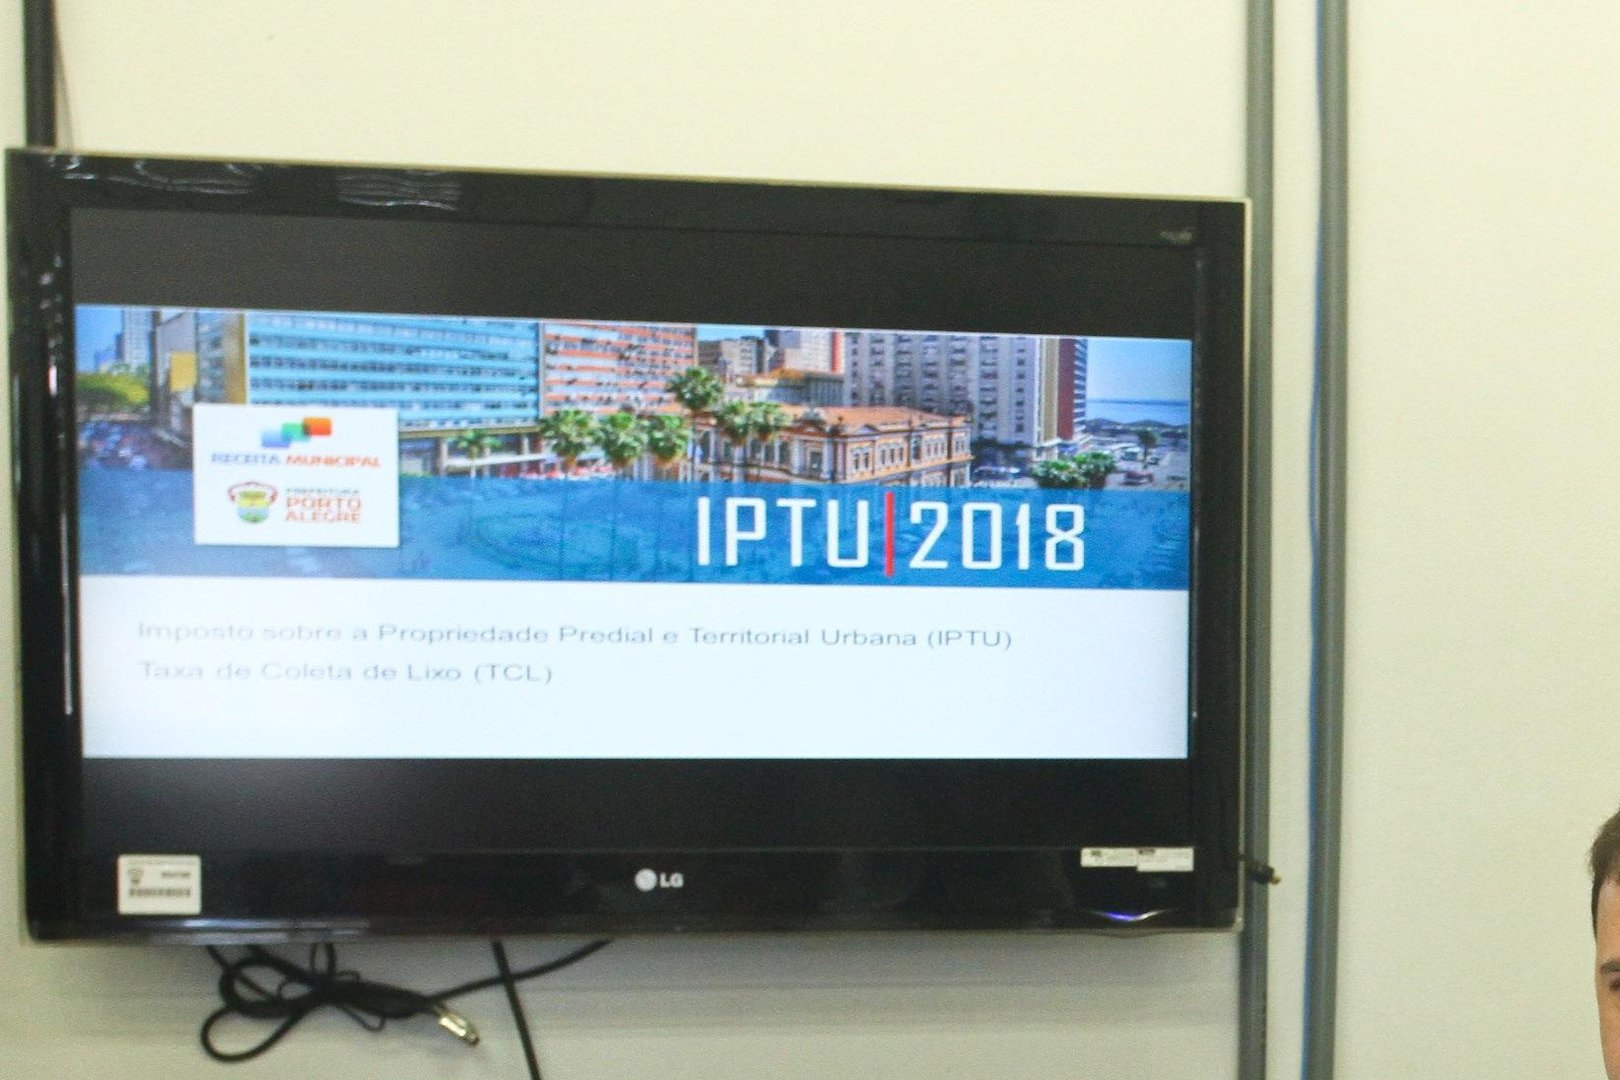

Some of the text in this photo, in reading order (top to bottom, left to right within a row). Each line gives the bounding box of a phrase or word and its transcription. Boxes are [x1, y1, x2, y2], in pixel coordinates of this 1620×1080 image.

[210, 452, 382, 468] RECEITA MUNICIPAL
[286, 496, 362, 512] PORTO
[285, 510, 362, 524] ALEGRE
[697, 496, 1085, 571] IPTU 2018
[137, 620, 1013, 651] Imposto sobre a Propriedade Predial e Territorial Urbana (IPTU)
[138, 660, 553, 685] Taxa de Coleta de Lixo (TCL)
[660, 872, 684, 888] LG
